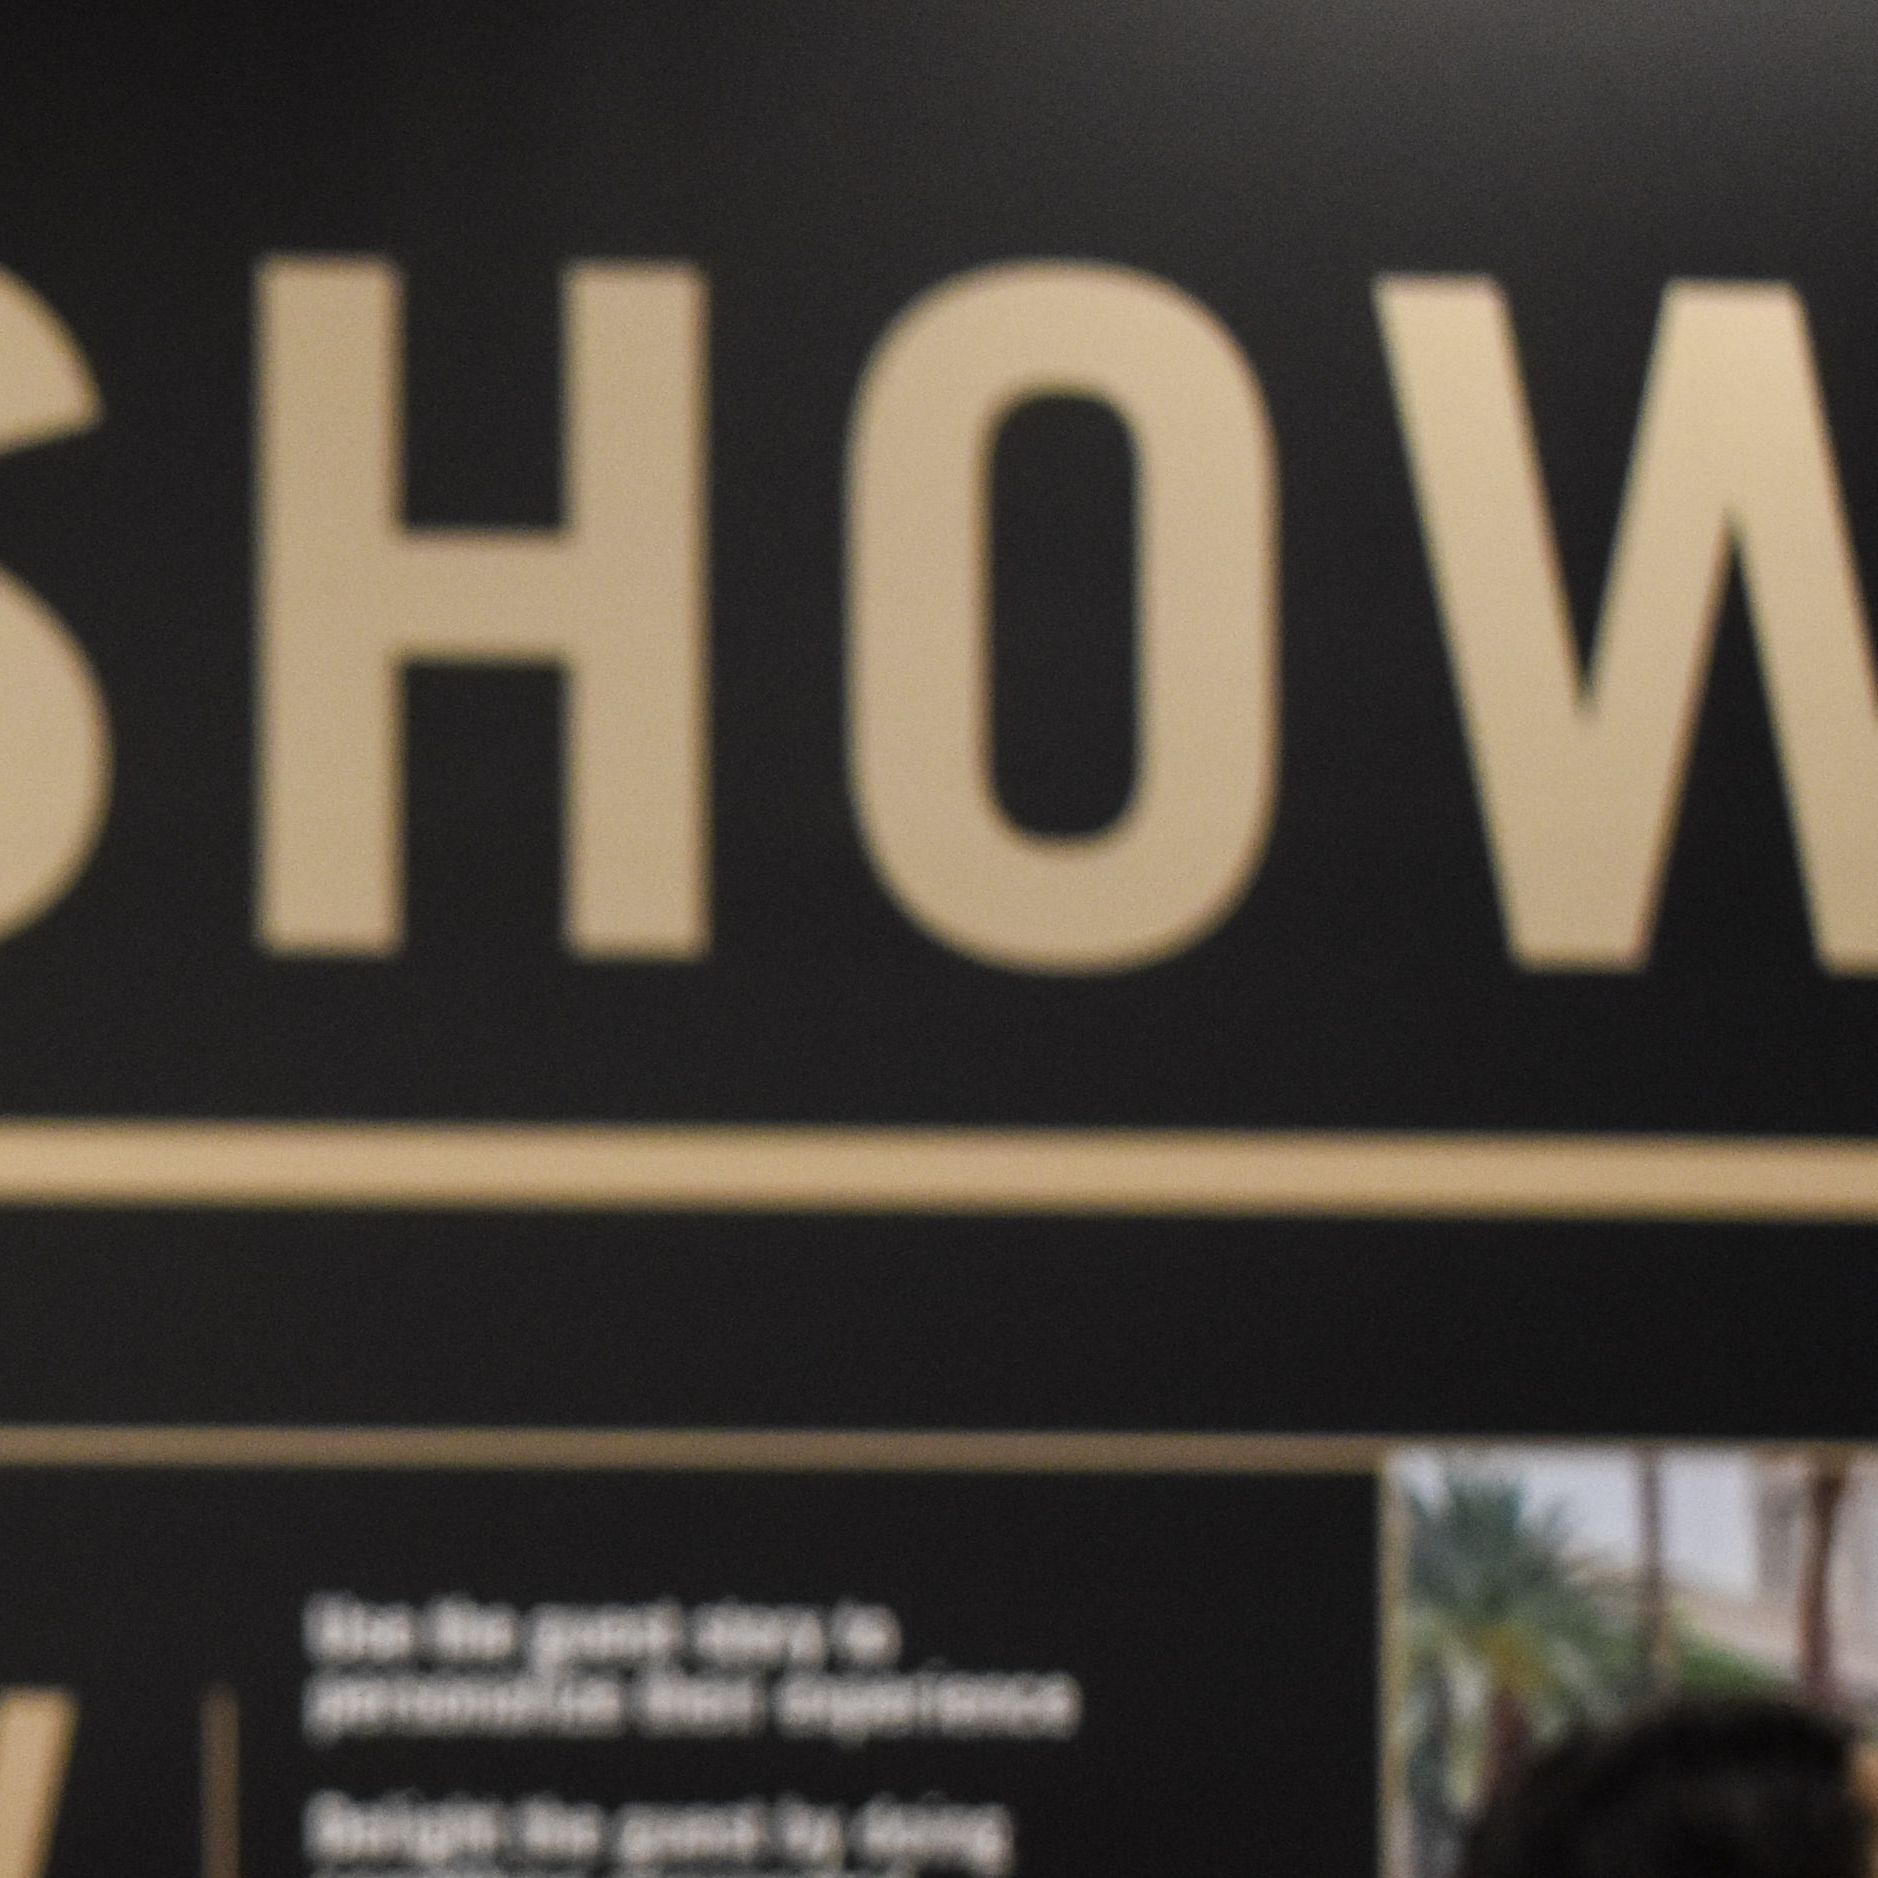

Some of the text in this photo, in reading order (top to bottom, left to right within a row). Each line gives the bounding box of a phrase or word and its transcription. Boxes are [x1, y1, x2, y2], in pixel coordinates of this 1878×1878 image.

[306, 1596, 897, 1676] Use the guest story to
[775, 1668, 1077, 1746] experience
[517, 1794, 606, 1860] the
[612, 1794, 768, 1874] guest
[775, 1794, 845, 1874] by
[854, 1794, 1010, 1874] doing
